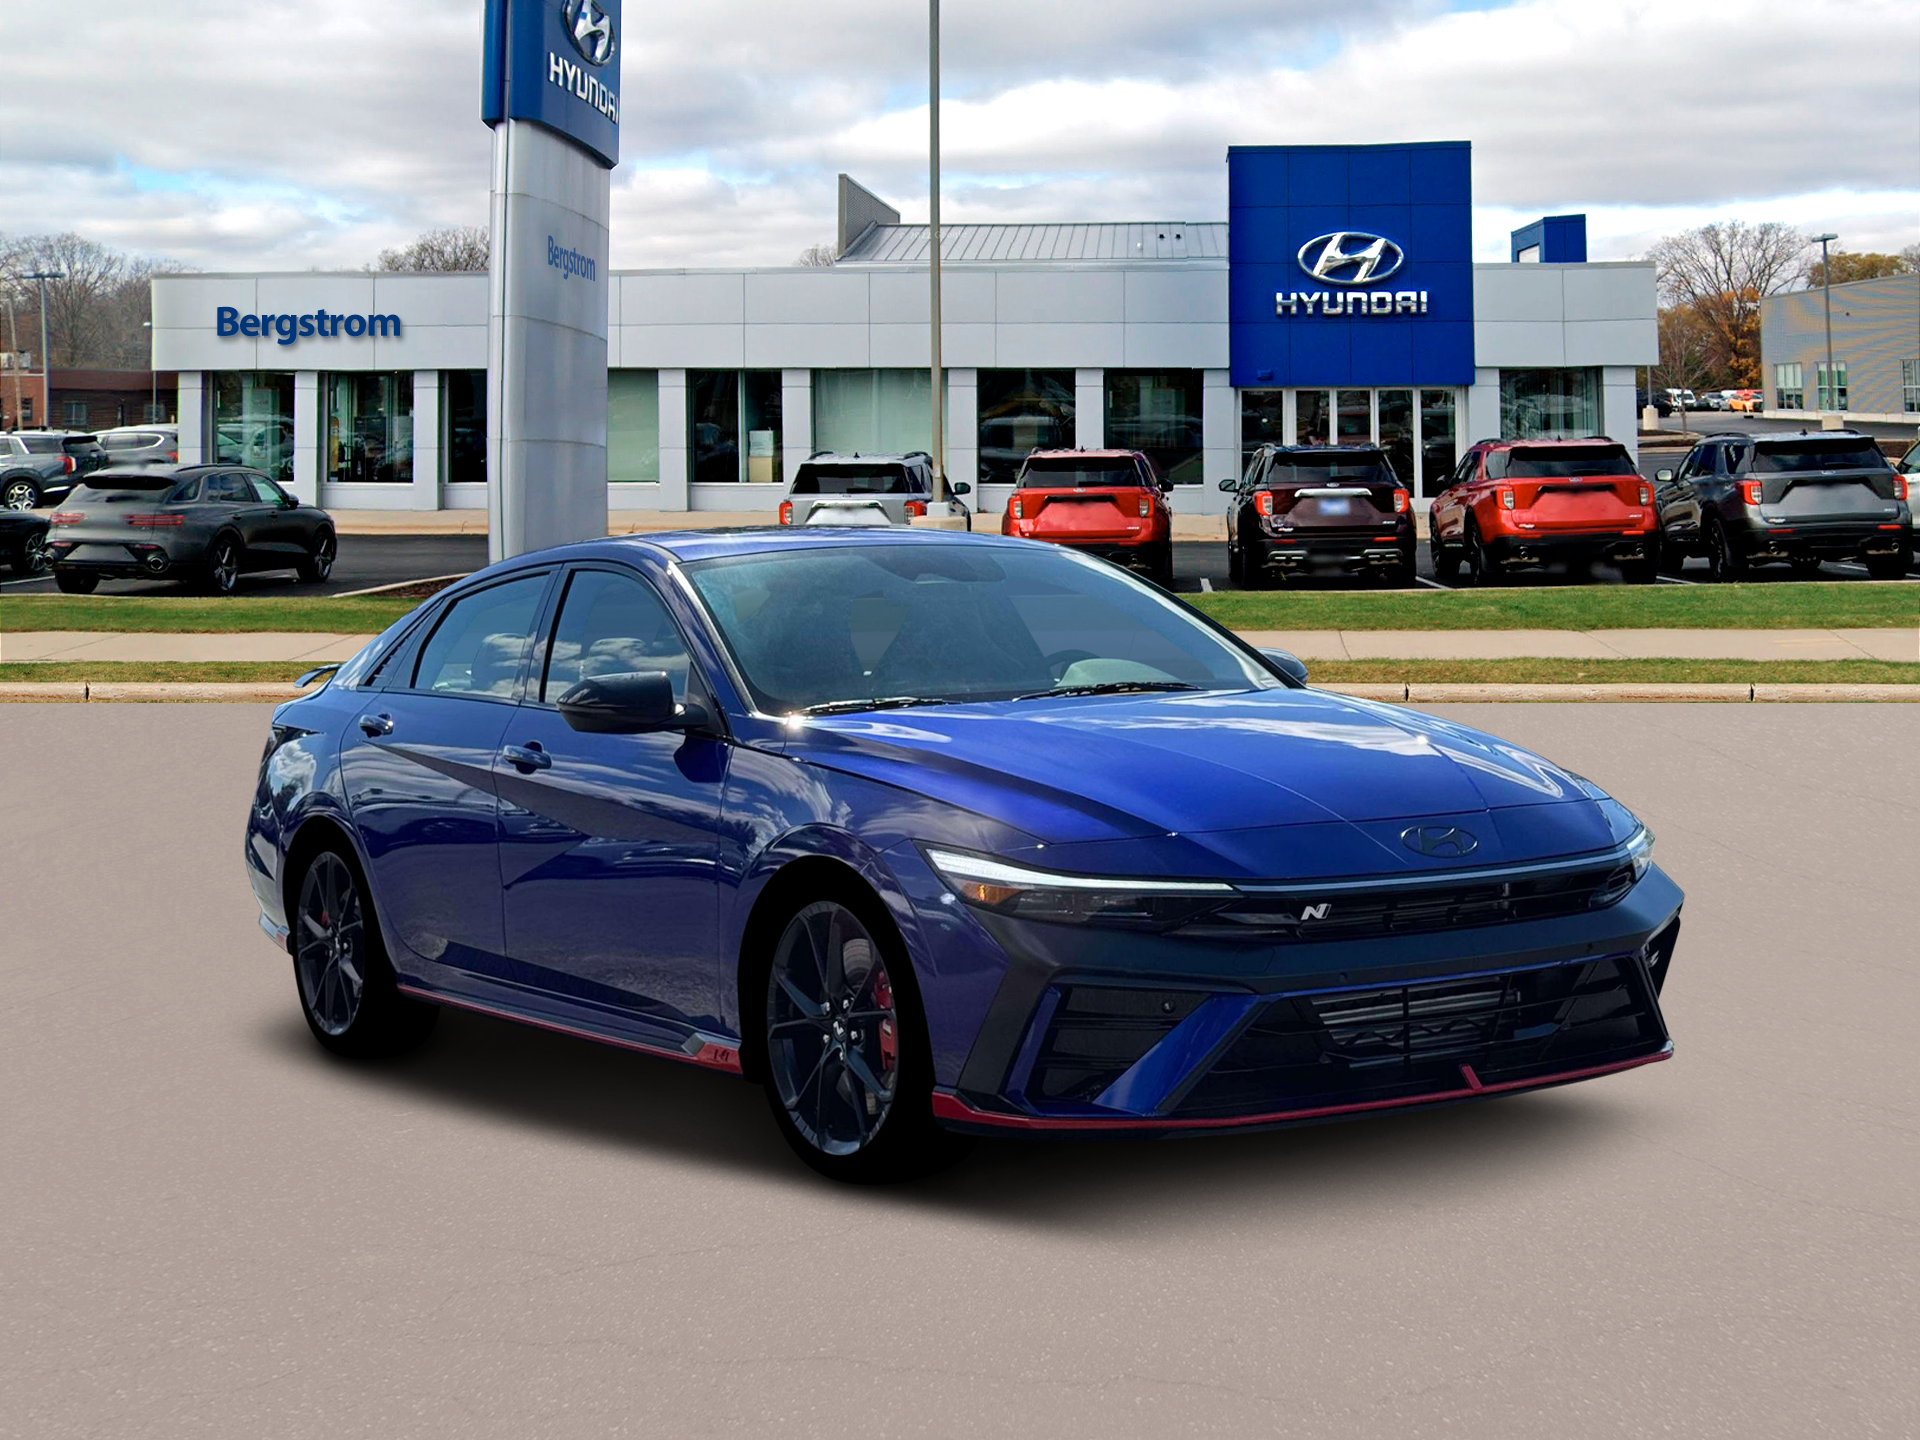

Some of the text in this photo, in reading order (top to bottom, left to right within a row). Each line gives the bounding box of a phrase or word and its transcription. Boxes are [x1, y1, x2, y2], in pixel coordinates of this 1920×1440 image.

[549, 52, 619, 124] HYUNDAI
[548, 235, 595, 281] Bergstrom
[1275, 291, 1428, 315] HYUNDAI
[217, 306, 401, 346] Bergstrom
